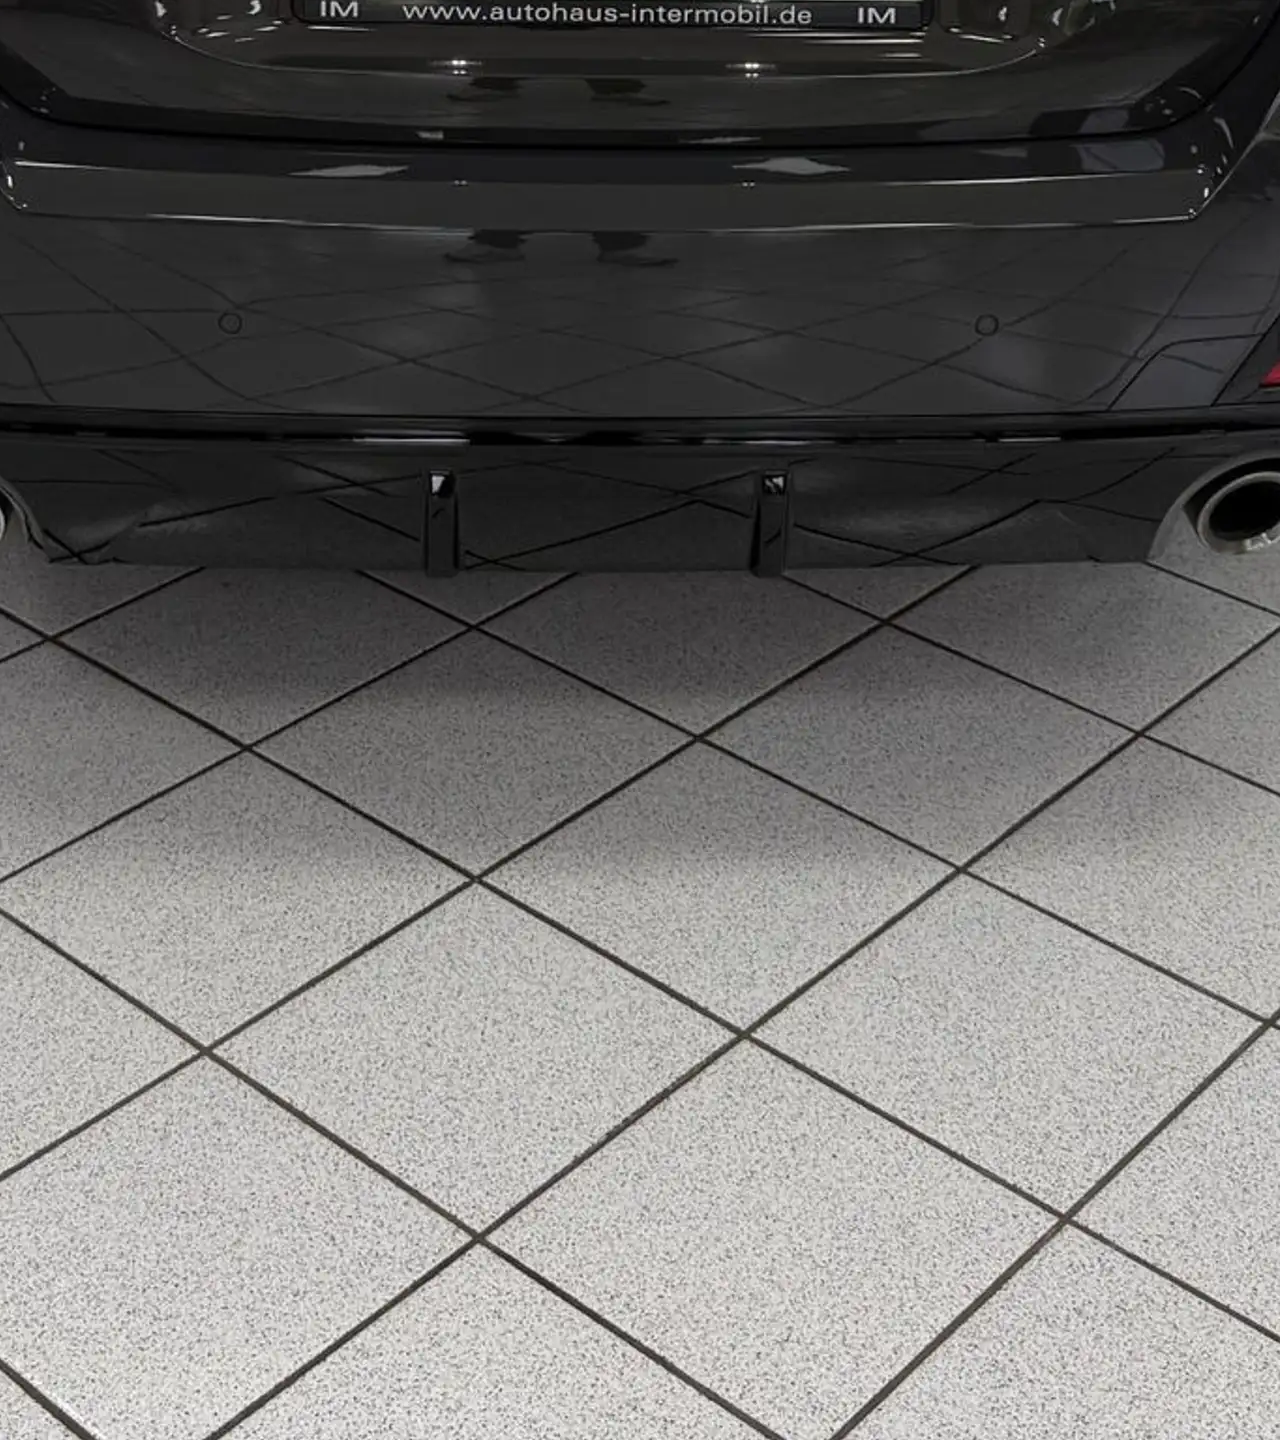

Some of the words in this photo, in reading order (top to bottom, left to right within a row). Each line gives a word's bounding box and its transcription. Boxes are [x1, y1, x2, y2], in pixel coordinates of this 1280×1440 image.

[320, 0, 359, 18] IM
[402, 2, 813, 26] www.autohaus-intermobil.de
[857, 7, 897, 24] IM
